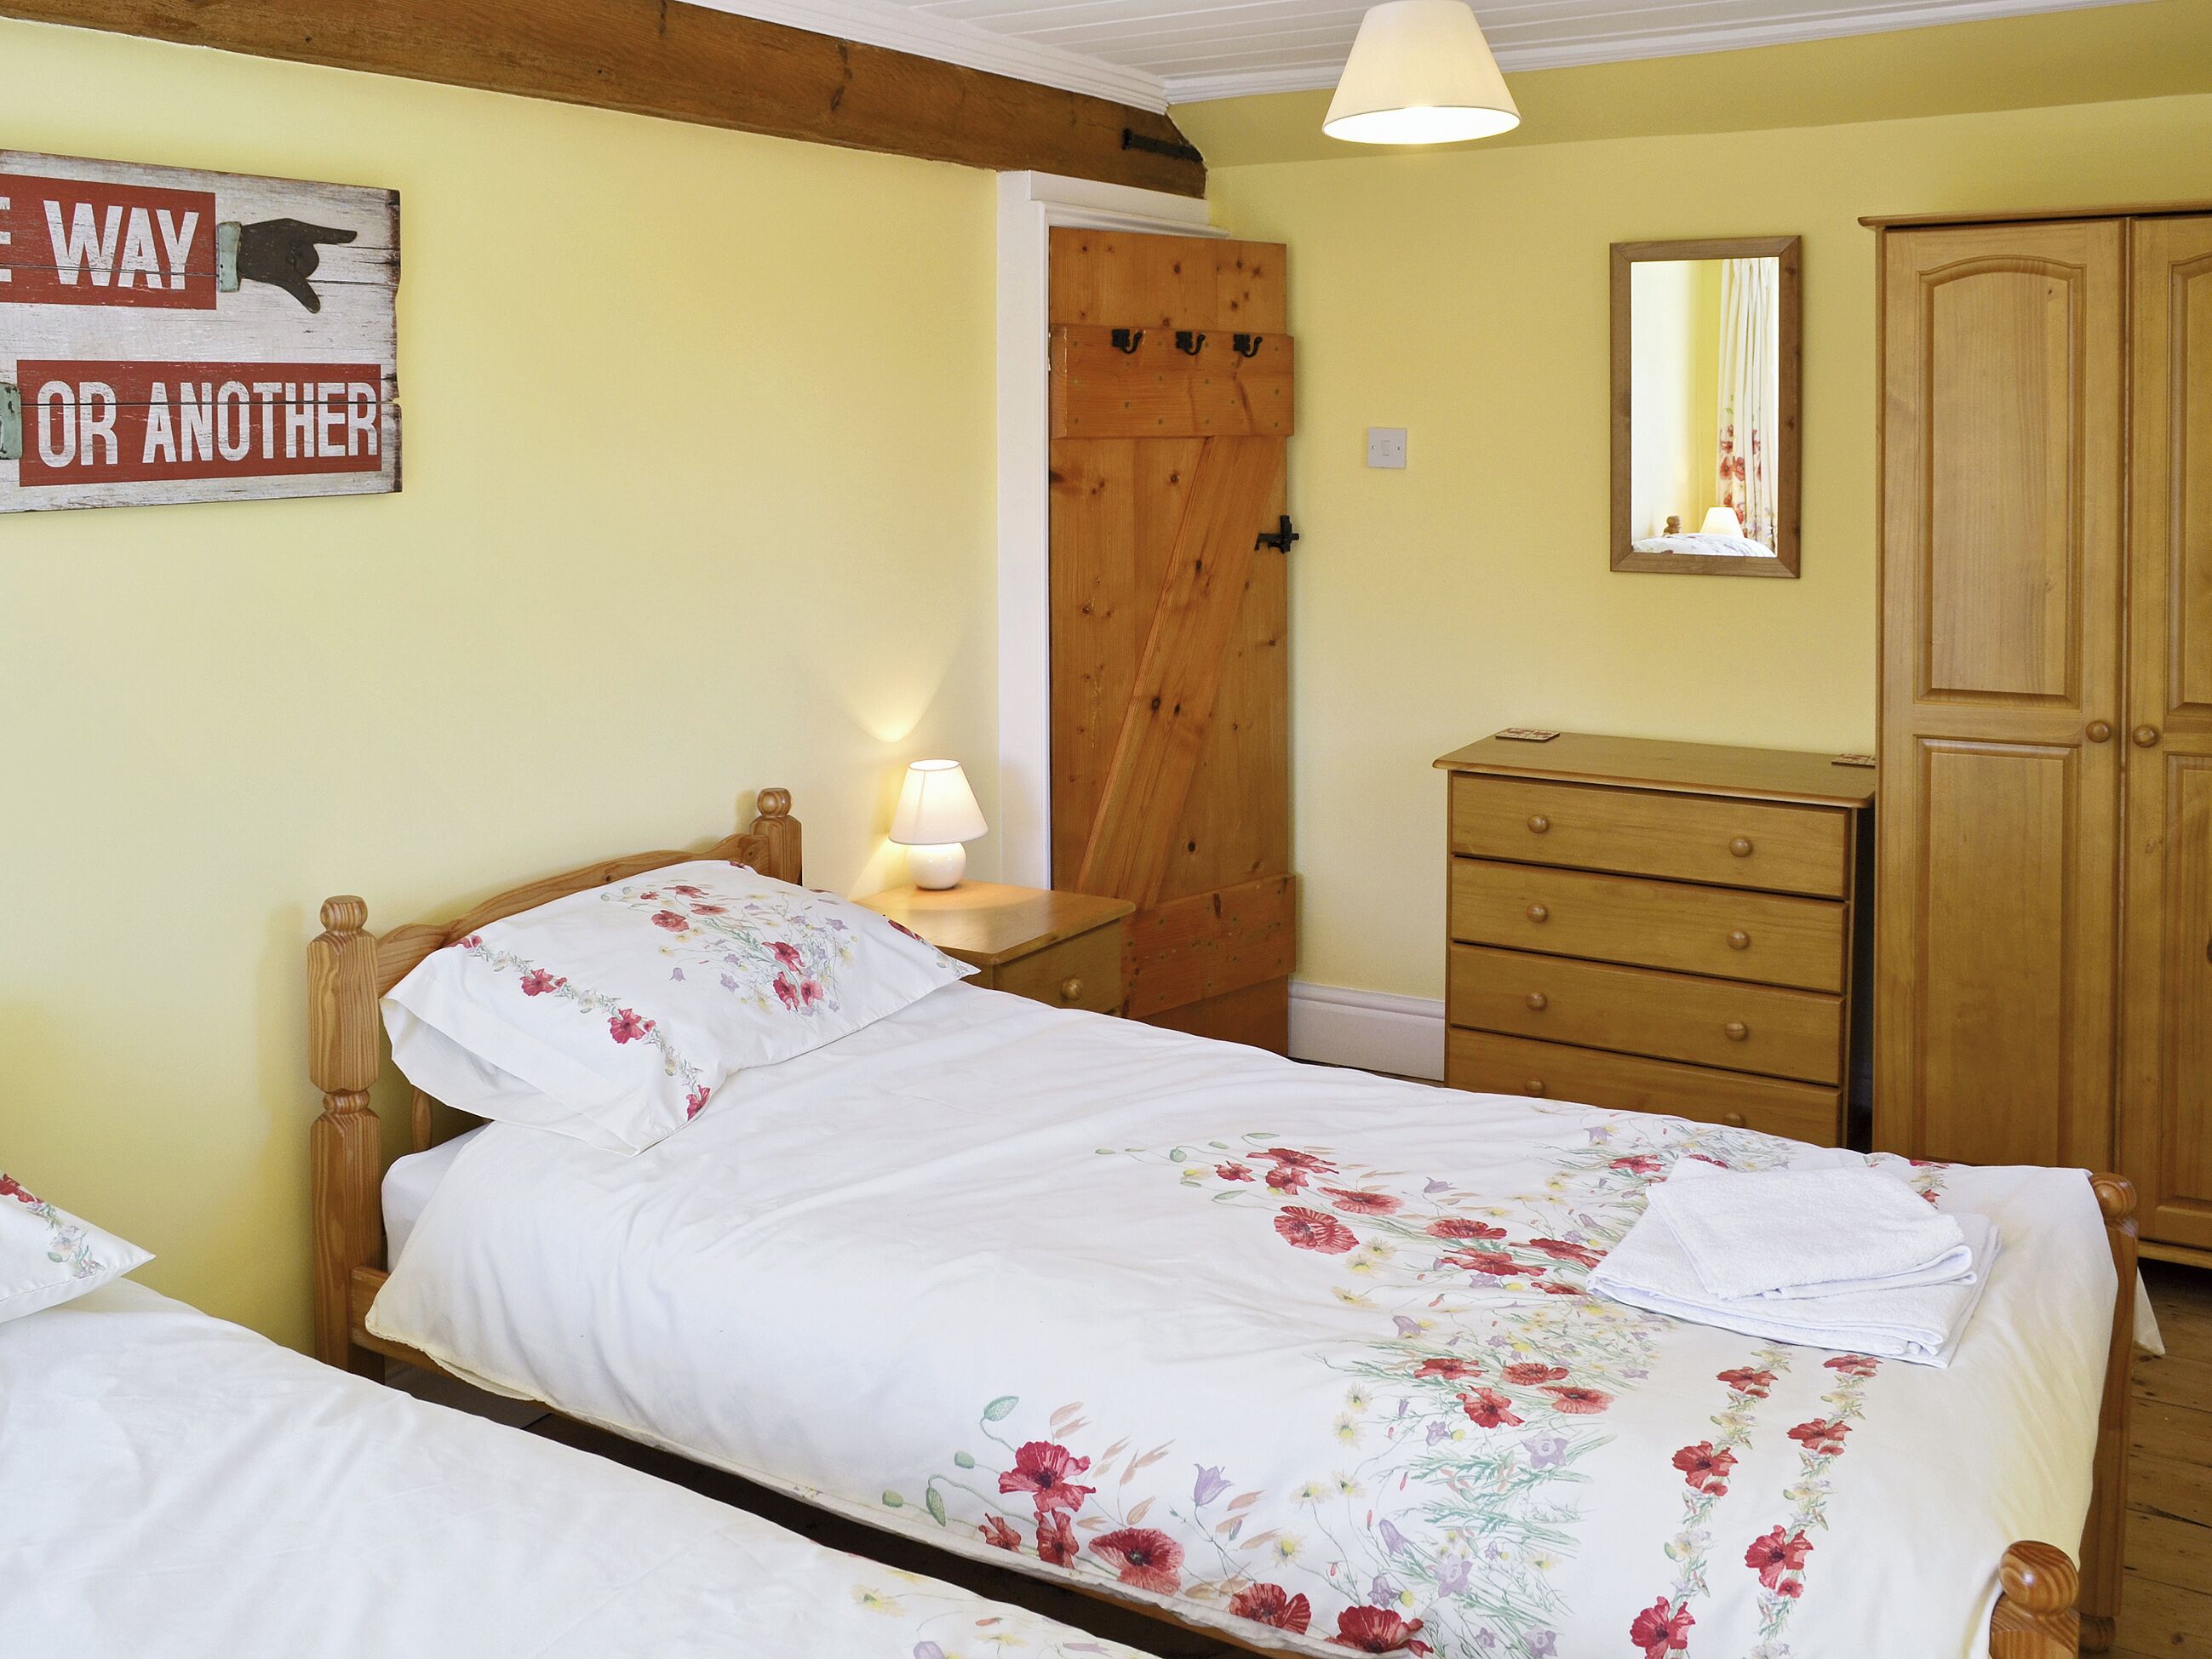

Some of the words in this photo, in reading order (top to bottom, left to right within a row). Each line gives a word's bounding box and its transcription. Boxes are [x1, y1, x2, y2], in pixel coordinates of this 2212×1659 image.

[43, 200, 200, 290] WAY
[37, 380, 119, 468] OR
[141, 380, 378, 464] ANOTHER
